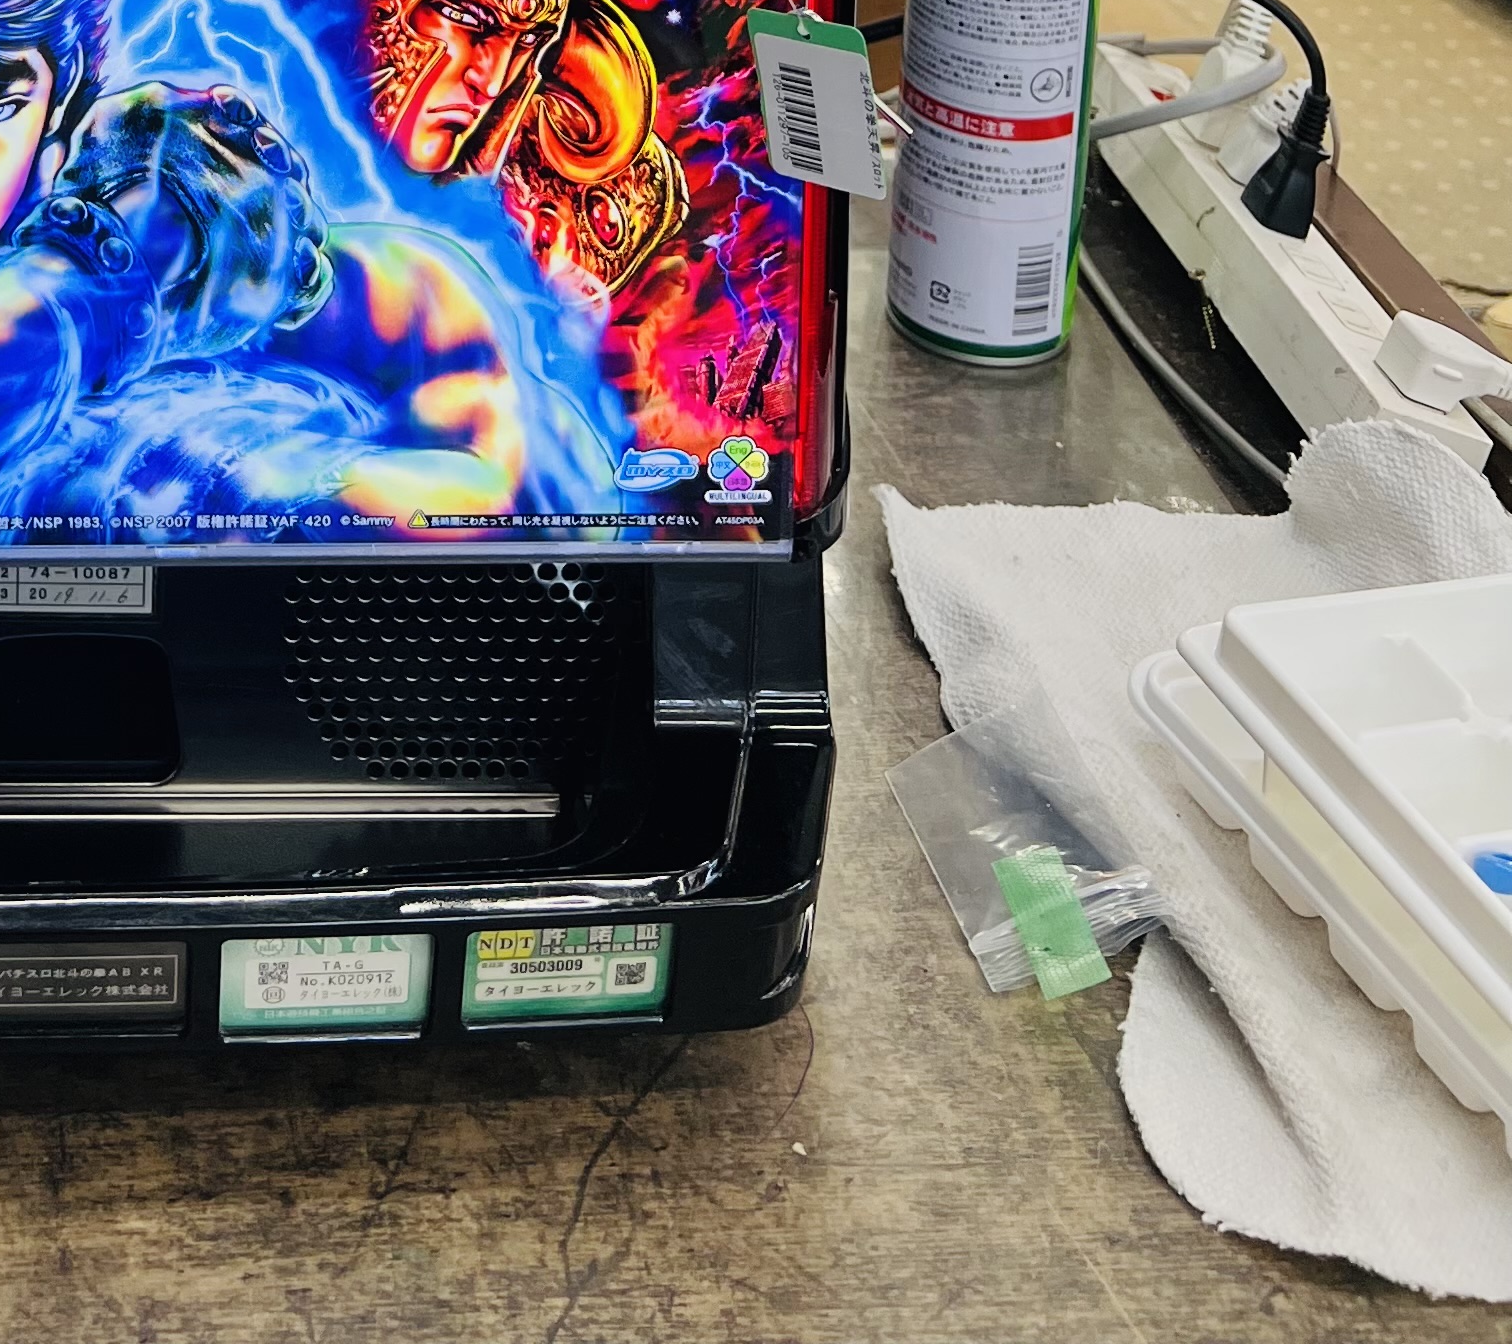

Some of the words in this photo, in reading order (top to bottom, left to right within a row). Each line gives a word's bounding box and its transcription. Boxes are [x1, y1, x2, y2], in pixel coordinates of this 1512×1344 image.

[729, 445, 748, 455] Eng
[156, 515, 192, 528] 2007
[0, 588, 8, 600] 3
[29, 587, 48, 600] 20
[322, 960, 365, 971] TA-G
[509, 958, 583, 974] 30503009
[484, 981, 596, 997] タイヨーエレック
